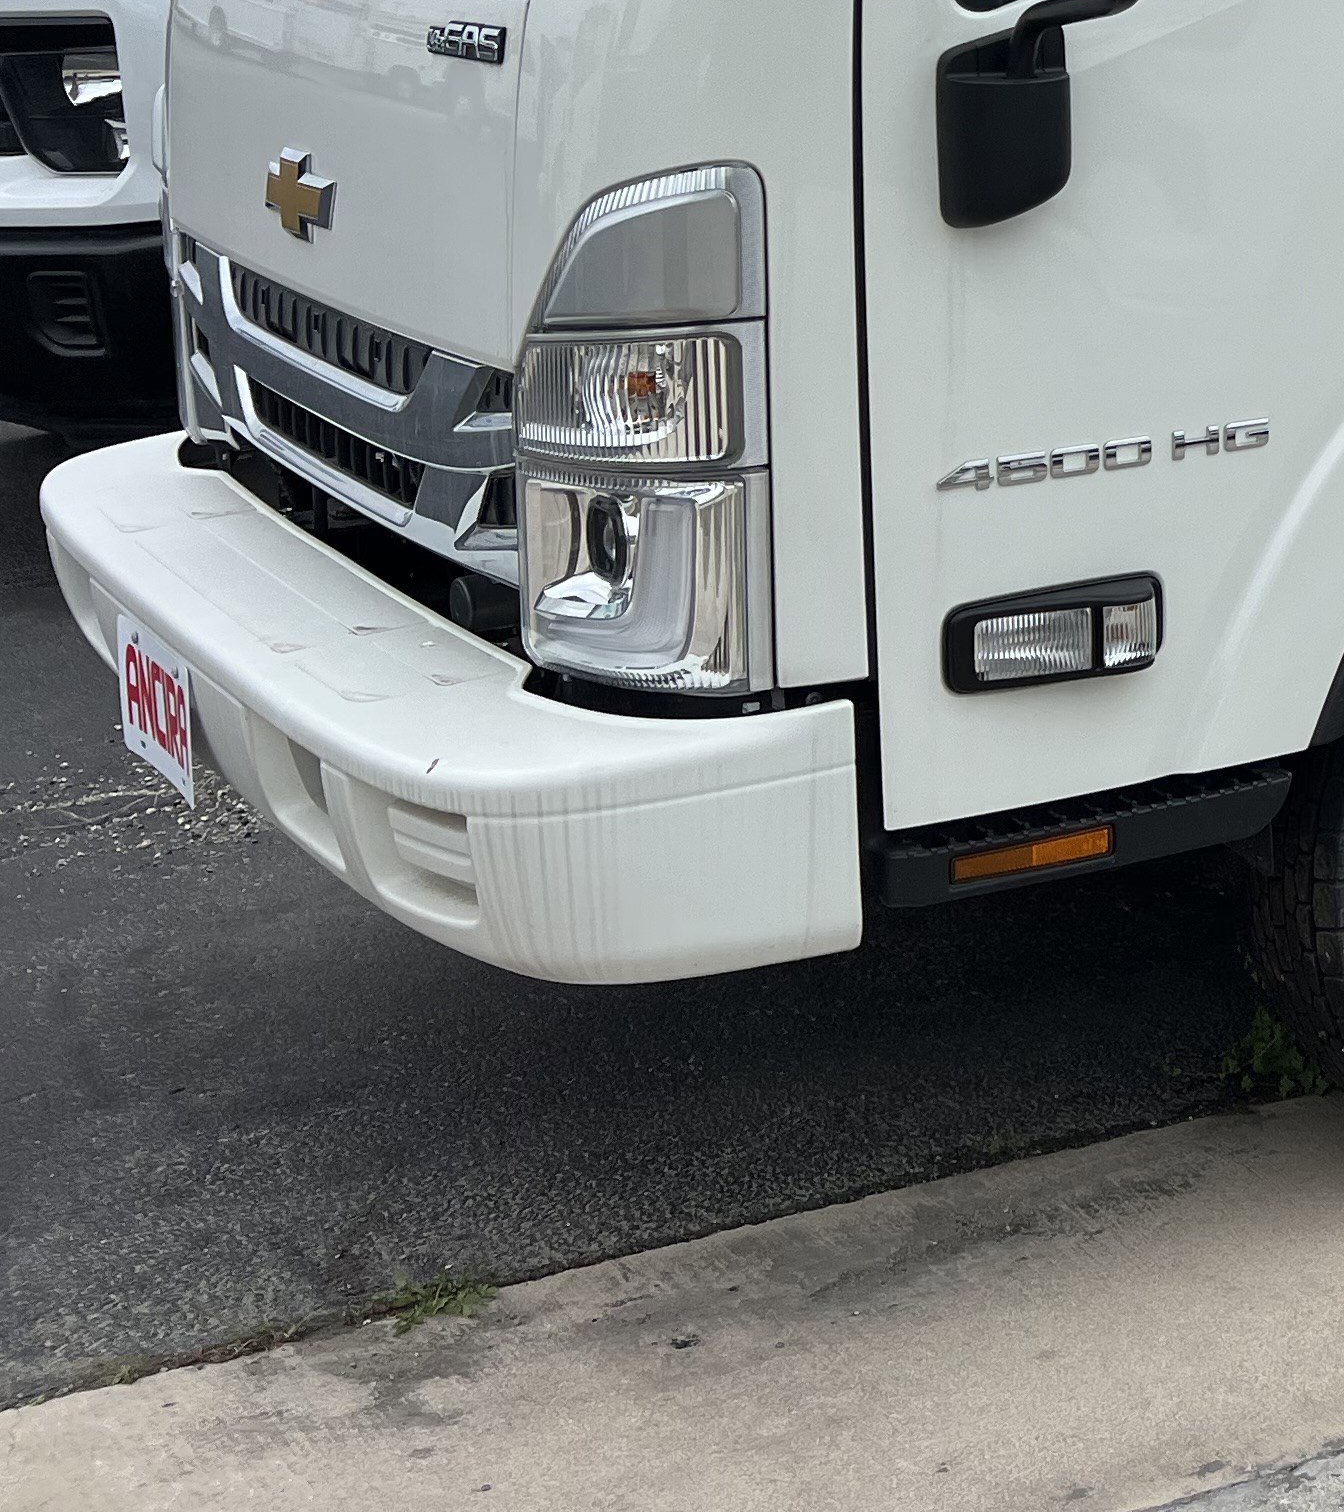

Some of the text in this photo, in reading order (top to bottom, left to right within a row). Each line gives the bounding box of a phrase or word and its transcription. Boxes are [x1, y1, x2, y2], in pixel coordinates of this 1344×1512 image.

[444, 22, 500, 61] GAS
[936, 416, 1270, 491] 4500 HG
[126, 643, 191, 780] ANCIRA
